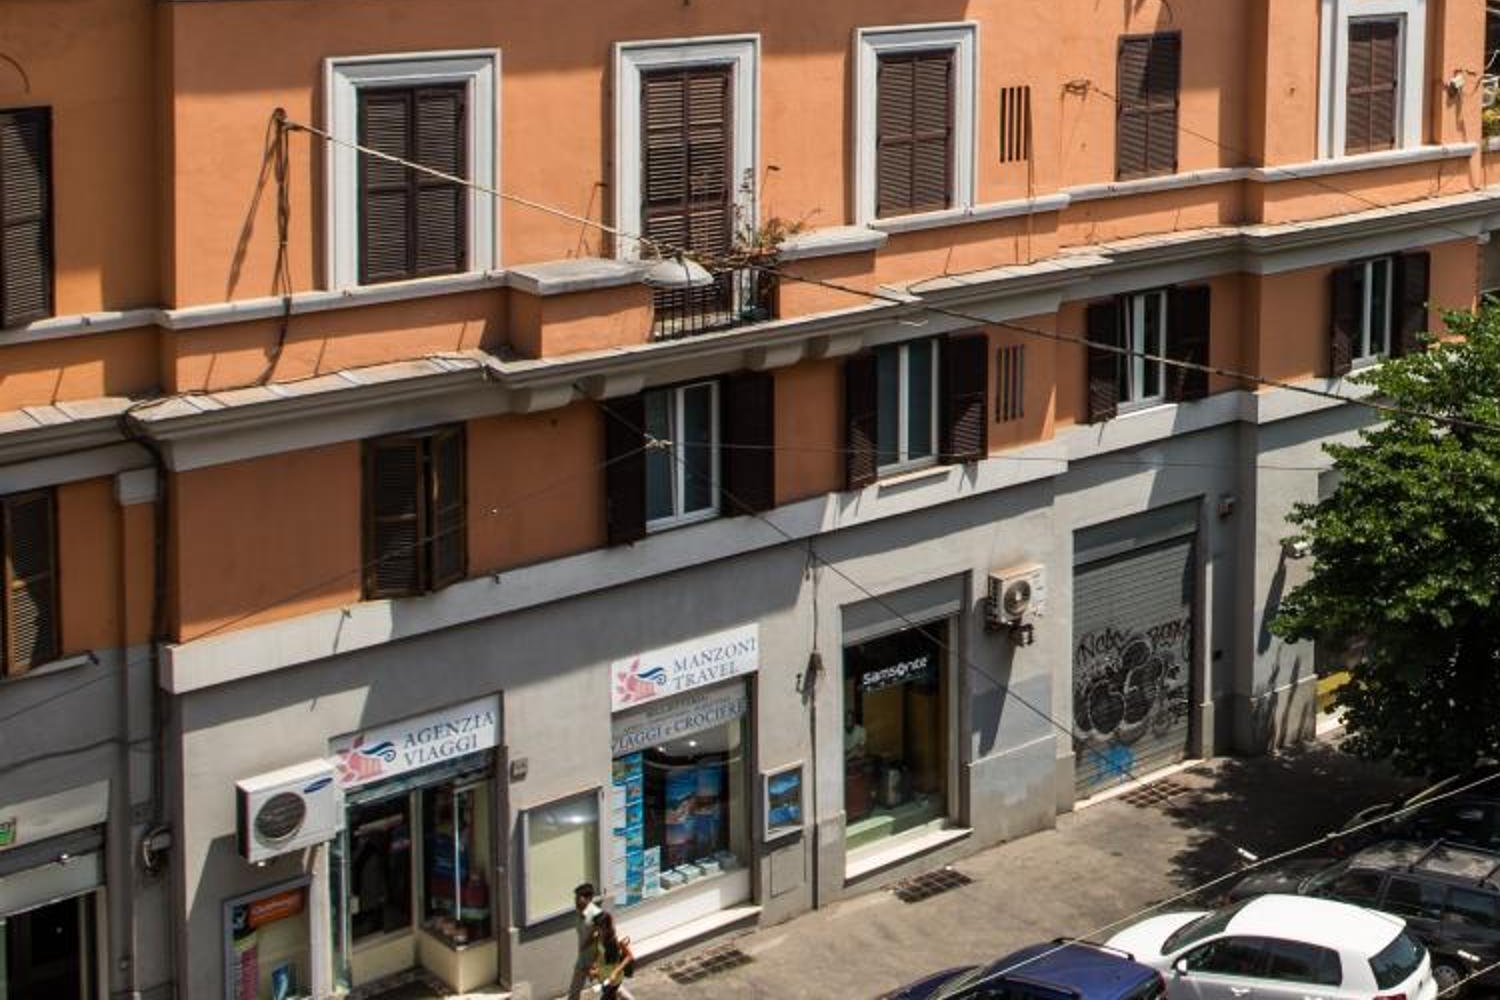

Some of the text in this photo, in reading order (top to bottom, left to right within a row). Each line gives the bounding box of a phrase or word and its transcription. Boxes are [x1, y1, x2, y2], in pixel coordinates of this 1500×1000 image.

[673, 637, 756, 674] MANZONI
[672, 661, 737, 690] TRAVEL
[404, 711, 494, 748] AGENZIA
[404, 734, 477, 766] VIAGGI
